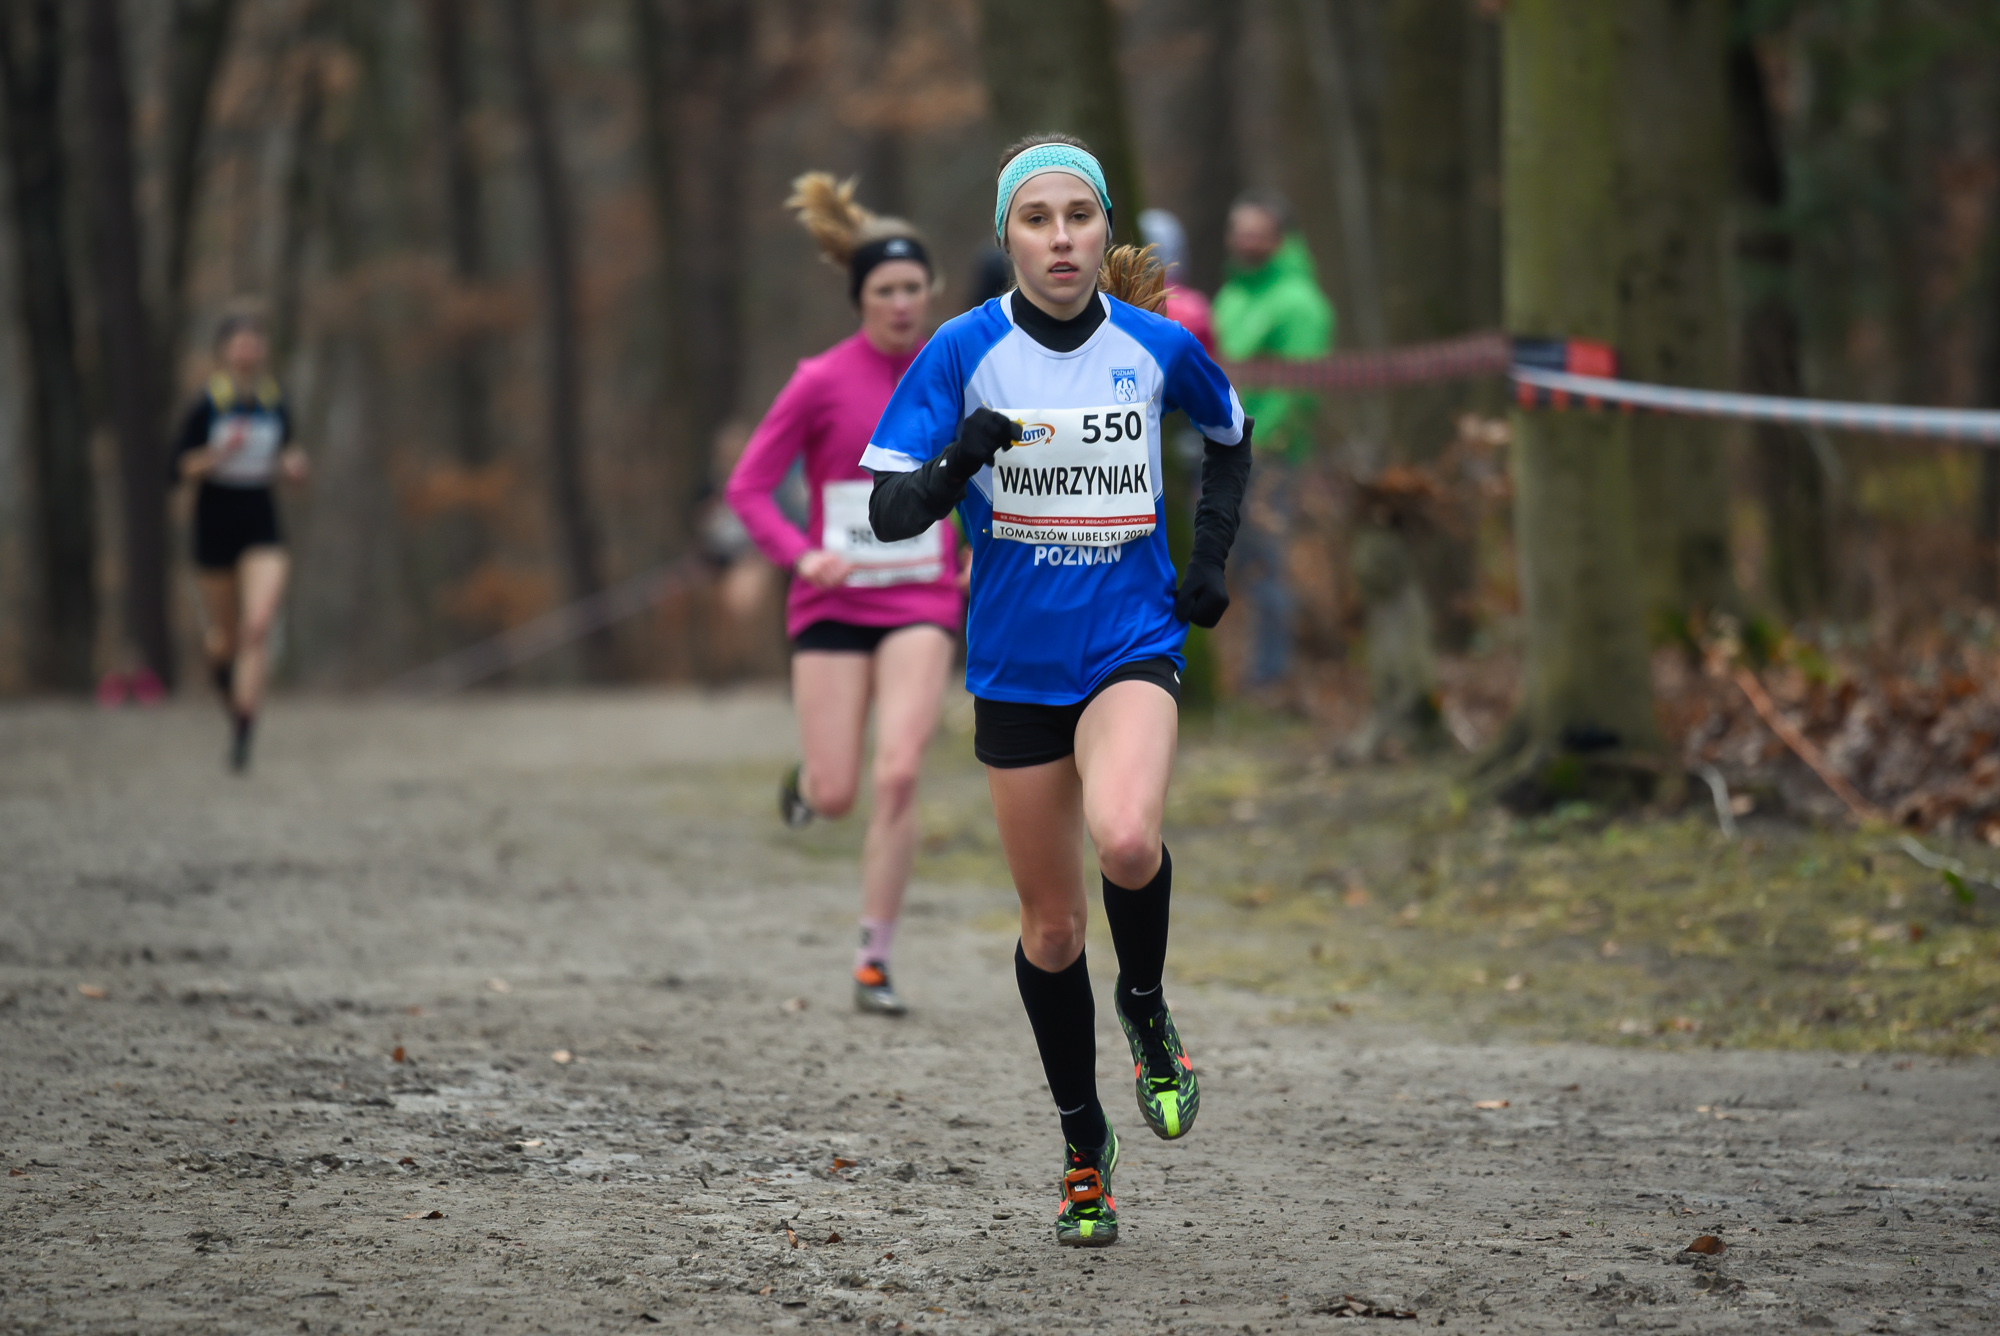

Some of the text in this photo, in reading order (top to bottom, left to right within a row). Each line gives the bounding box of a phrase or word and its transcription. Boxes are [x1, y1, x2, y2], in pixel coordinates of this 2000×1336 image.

[1021, 427, 1046, 441] OTTO
[1081, 411, 1142, 444] 550
[998, 463, 1148, 496] WAWRZYNIAK
[1000, 526, 1148, 542] TOMASZÓW LUBELSKI 2021
